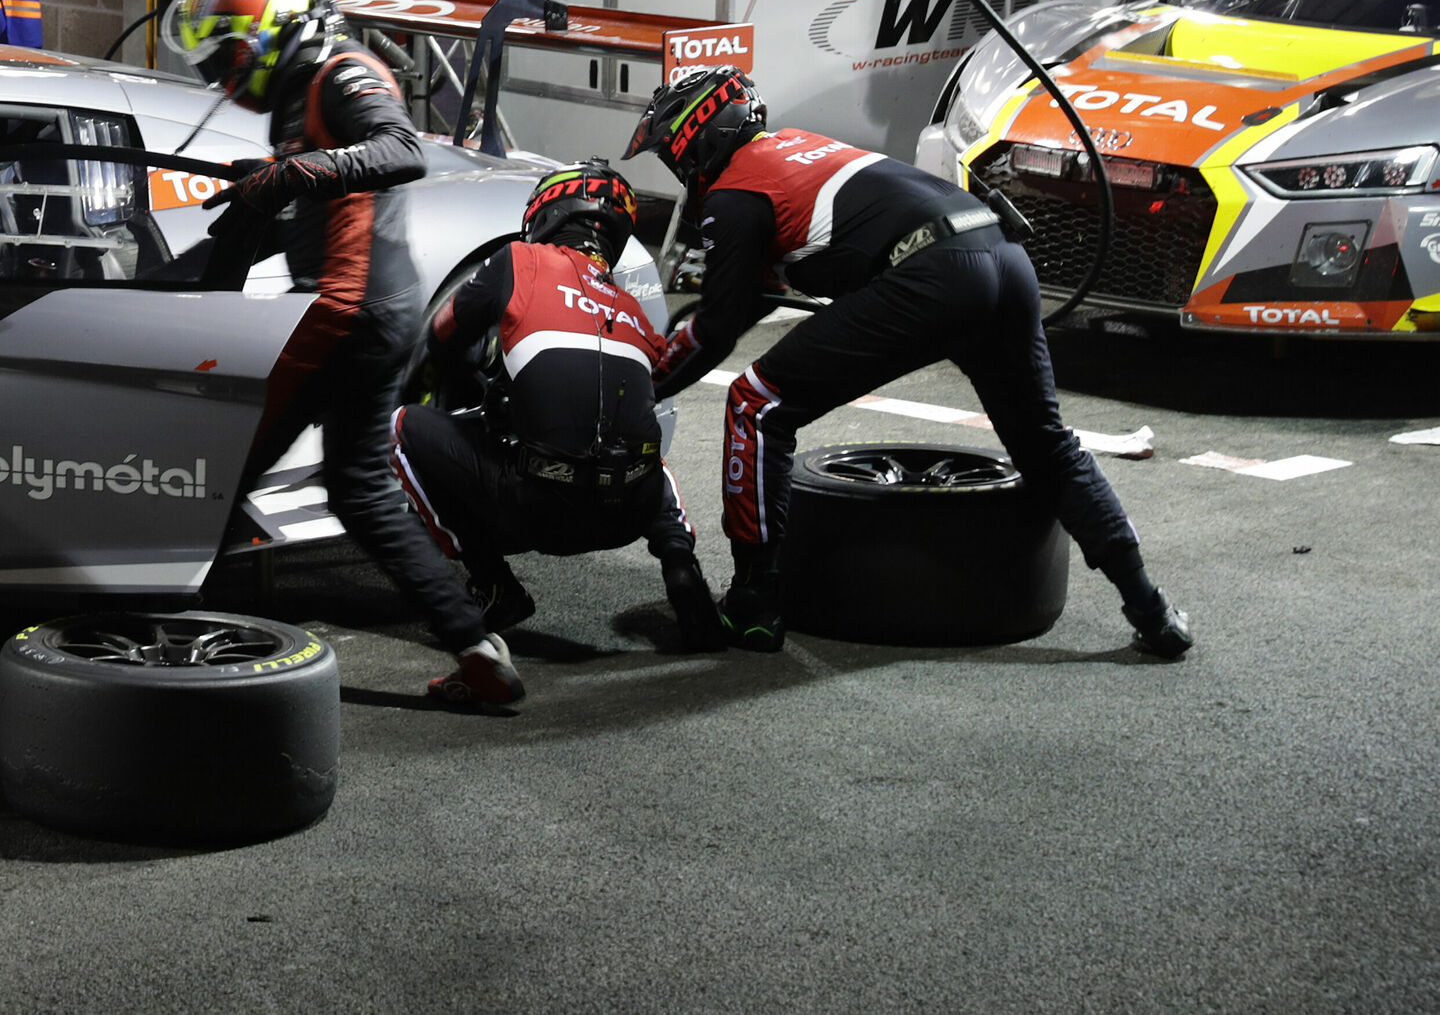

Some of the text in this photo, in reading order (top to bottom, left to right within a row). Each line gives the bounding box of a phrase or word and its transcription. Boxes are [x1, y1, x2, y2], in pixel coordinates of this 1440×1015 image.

[669, 35, 748, 60] TOTAL
[671, 76, 742, 161] SCOTT
[1049, 83, 1226, 132] TOTAL
[557, 285, 646, 337] TOTAL
[1243, 305, 1340, 325] TOTAL
[725, 400, 749, 499] TOTAL
